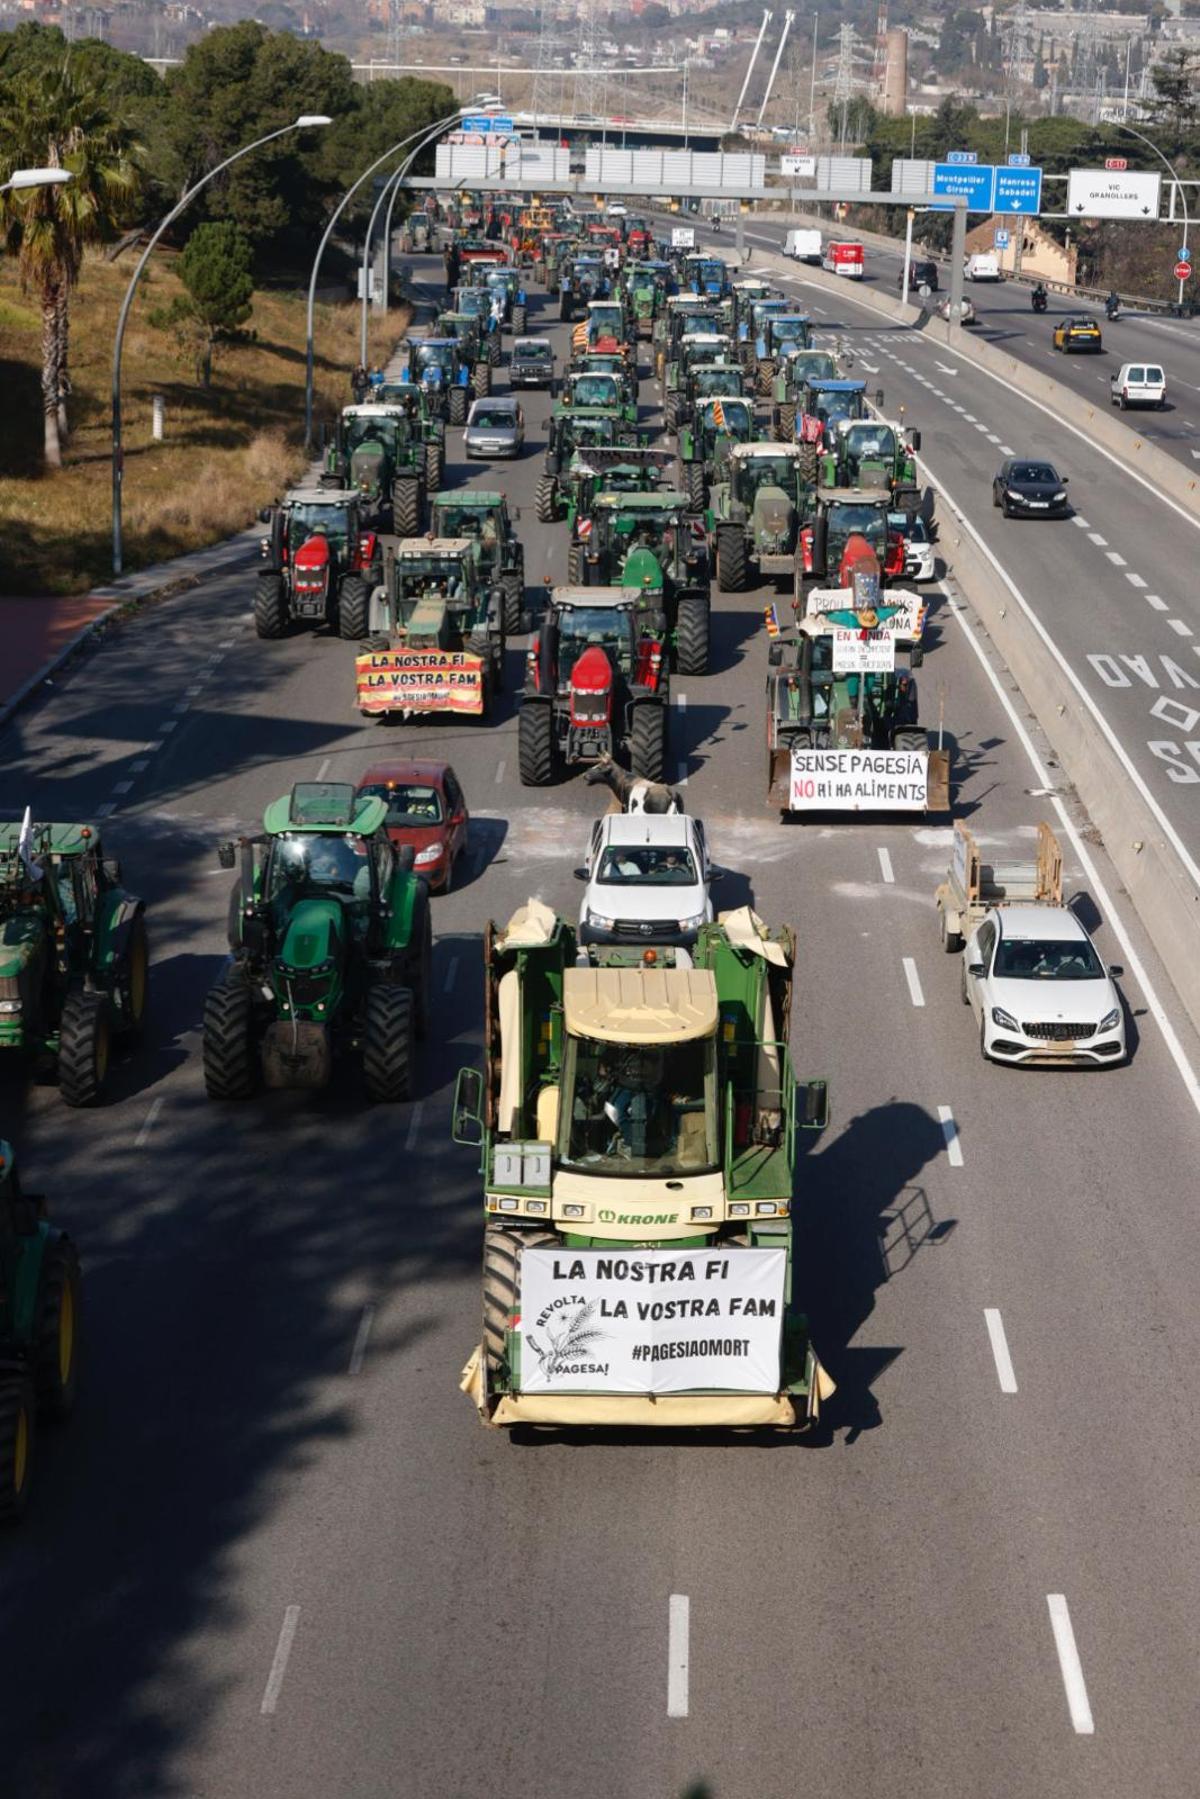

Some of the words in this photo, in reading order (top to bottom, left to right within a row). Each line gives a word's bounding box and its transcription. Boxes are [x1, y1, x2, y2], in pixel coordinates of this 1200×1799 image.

[945, 185, 975, 194] Girona
[999, 188, 1036, 196] Sabadell
[1108, 183, 1121, 191] VIC
[1089, 191, 1139, 200] GRANOLLERS
[836, 631, 851, 641] EN
[855, 631, 891, 641] VNDA
[372, 656, 389, 667] LA
[395, 655, 447, 667] NOSTRA
[452, 654, 464, 665] FI
[1086, 654, 1200, 688] VAO
[368, 675, 385, 686] LA
[391, 673, 443, 685] VOSTRA
[449, 674, 476, 685] FAM
[795, 755, 847, 773] SENSE
[794, 780, 814, 798] NO
[836, 783, 852, 797] HA
[617, 1213, 680, 1226] KRONE
[553, 1260, 587, 1280] LA
[596, 1259, 695, 1283] NOSTRA
[705, 1260, 729, 1280] FI
[536, 1295, 586, 1327] REVOLTA
[600, 1299, 628, 1319] LA
[637, 1298, 720, 1321] VOSTRA
[729, 1298, 776, 1318] FAM
[632, 1339, 750, 1362] #PAGESIAOMORT
[554, 1363, 609, 1377] PAGESA!
